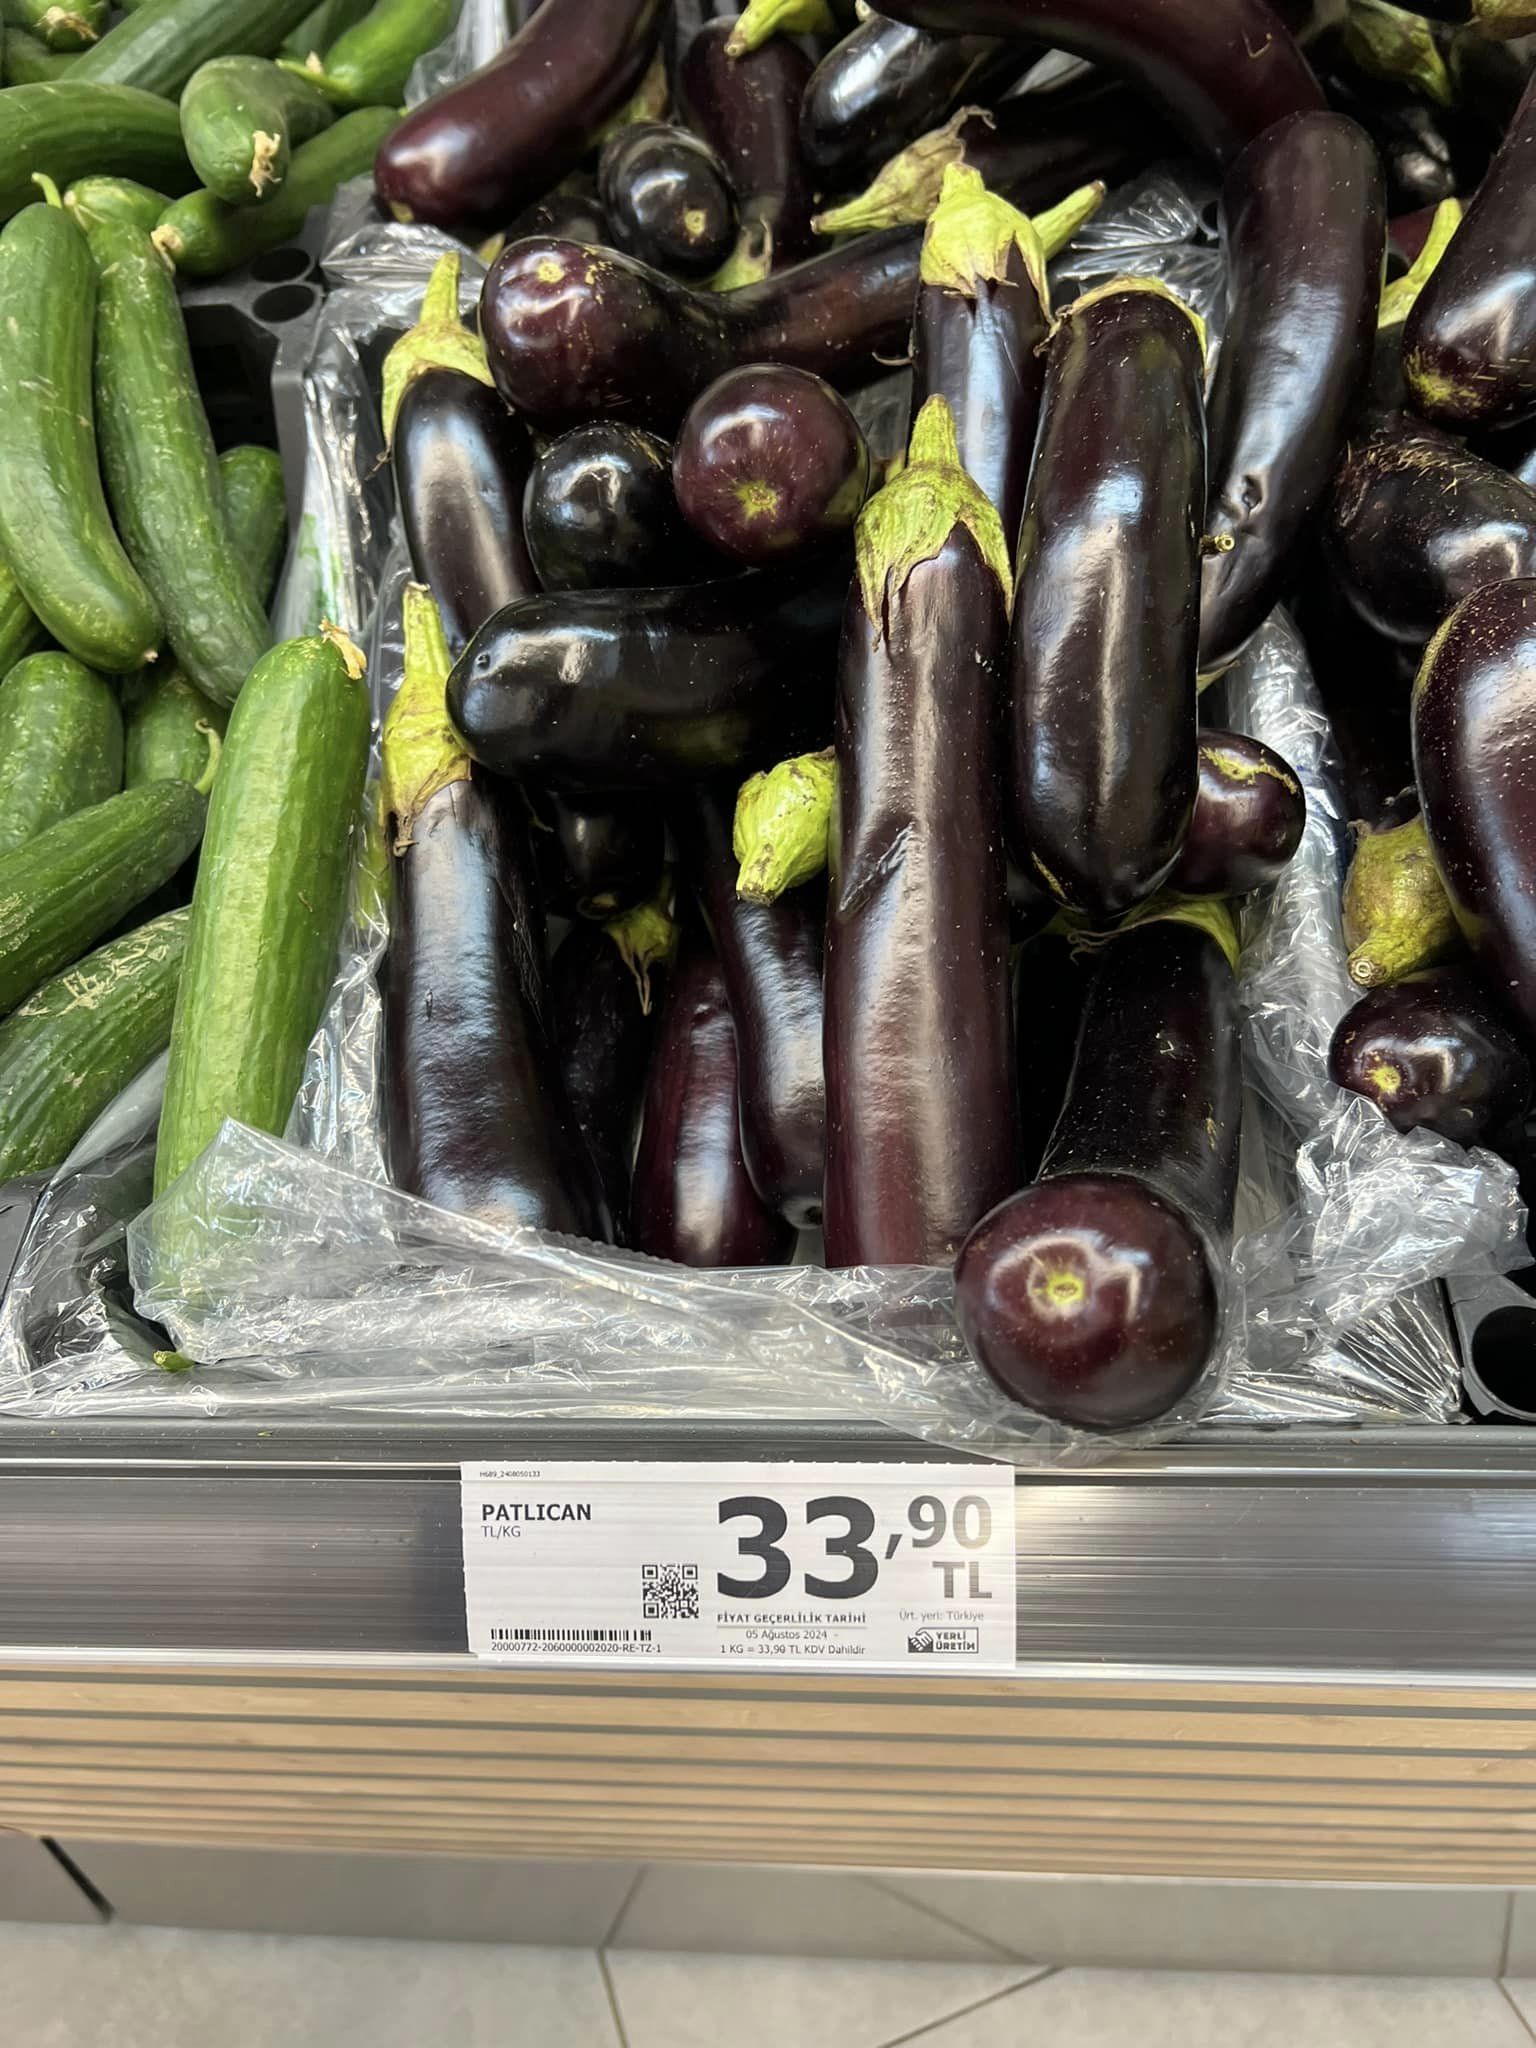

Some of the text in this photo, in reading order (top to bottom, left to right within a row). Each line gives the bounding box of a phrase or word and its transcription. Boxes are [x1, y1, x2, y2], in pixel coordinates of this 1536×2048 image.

[481, 1503, 592, 1521] PATLICAN
[481, 1525, 521, 1540] TL/KG
[932, 1561, 993, 1599] TL
[716, 1610, 867, 1625] FİYAT GEÇERLİLİK TARİHİ
[745, 1629, 758, 1640] 05
[761, 1629, 801, 1641] Ağustos
[803, 1630, 827, 1640] 2024
[936, 1630, 967, 1641] YERLİ
[720, 1644, 726, 1654] 1
[729, 1644, 744, 1654] KG
[758, 1644, 786, 1656] 33,90
[788, 1645, 801, 1655] TL
[804, 1645, 825, 1655] KDV
[828, 1644, 866, 1655] Dahildir
[935, 1641, 976, 1651] ÜRETİM
